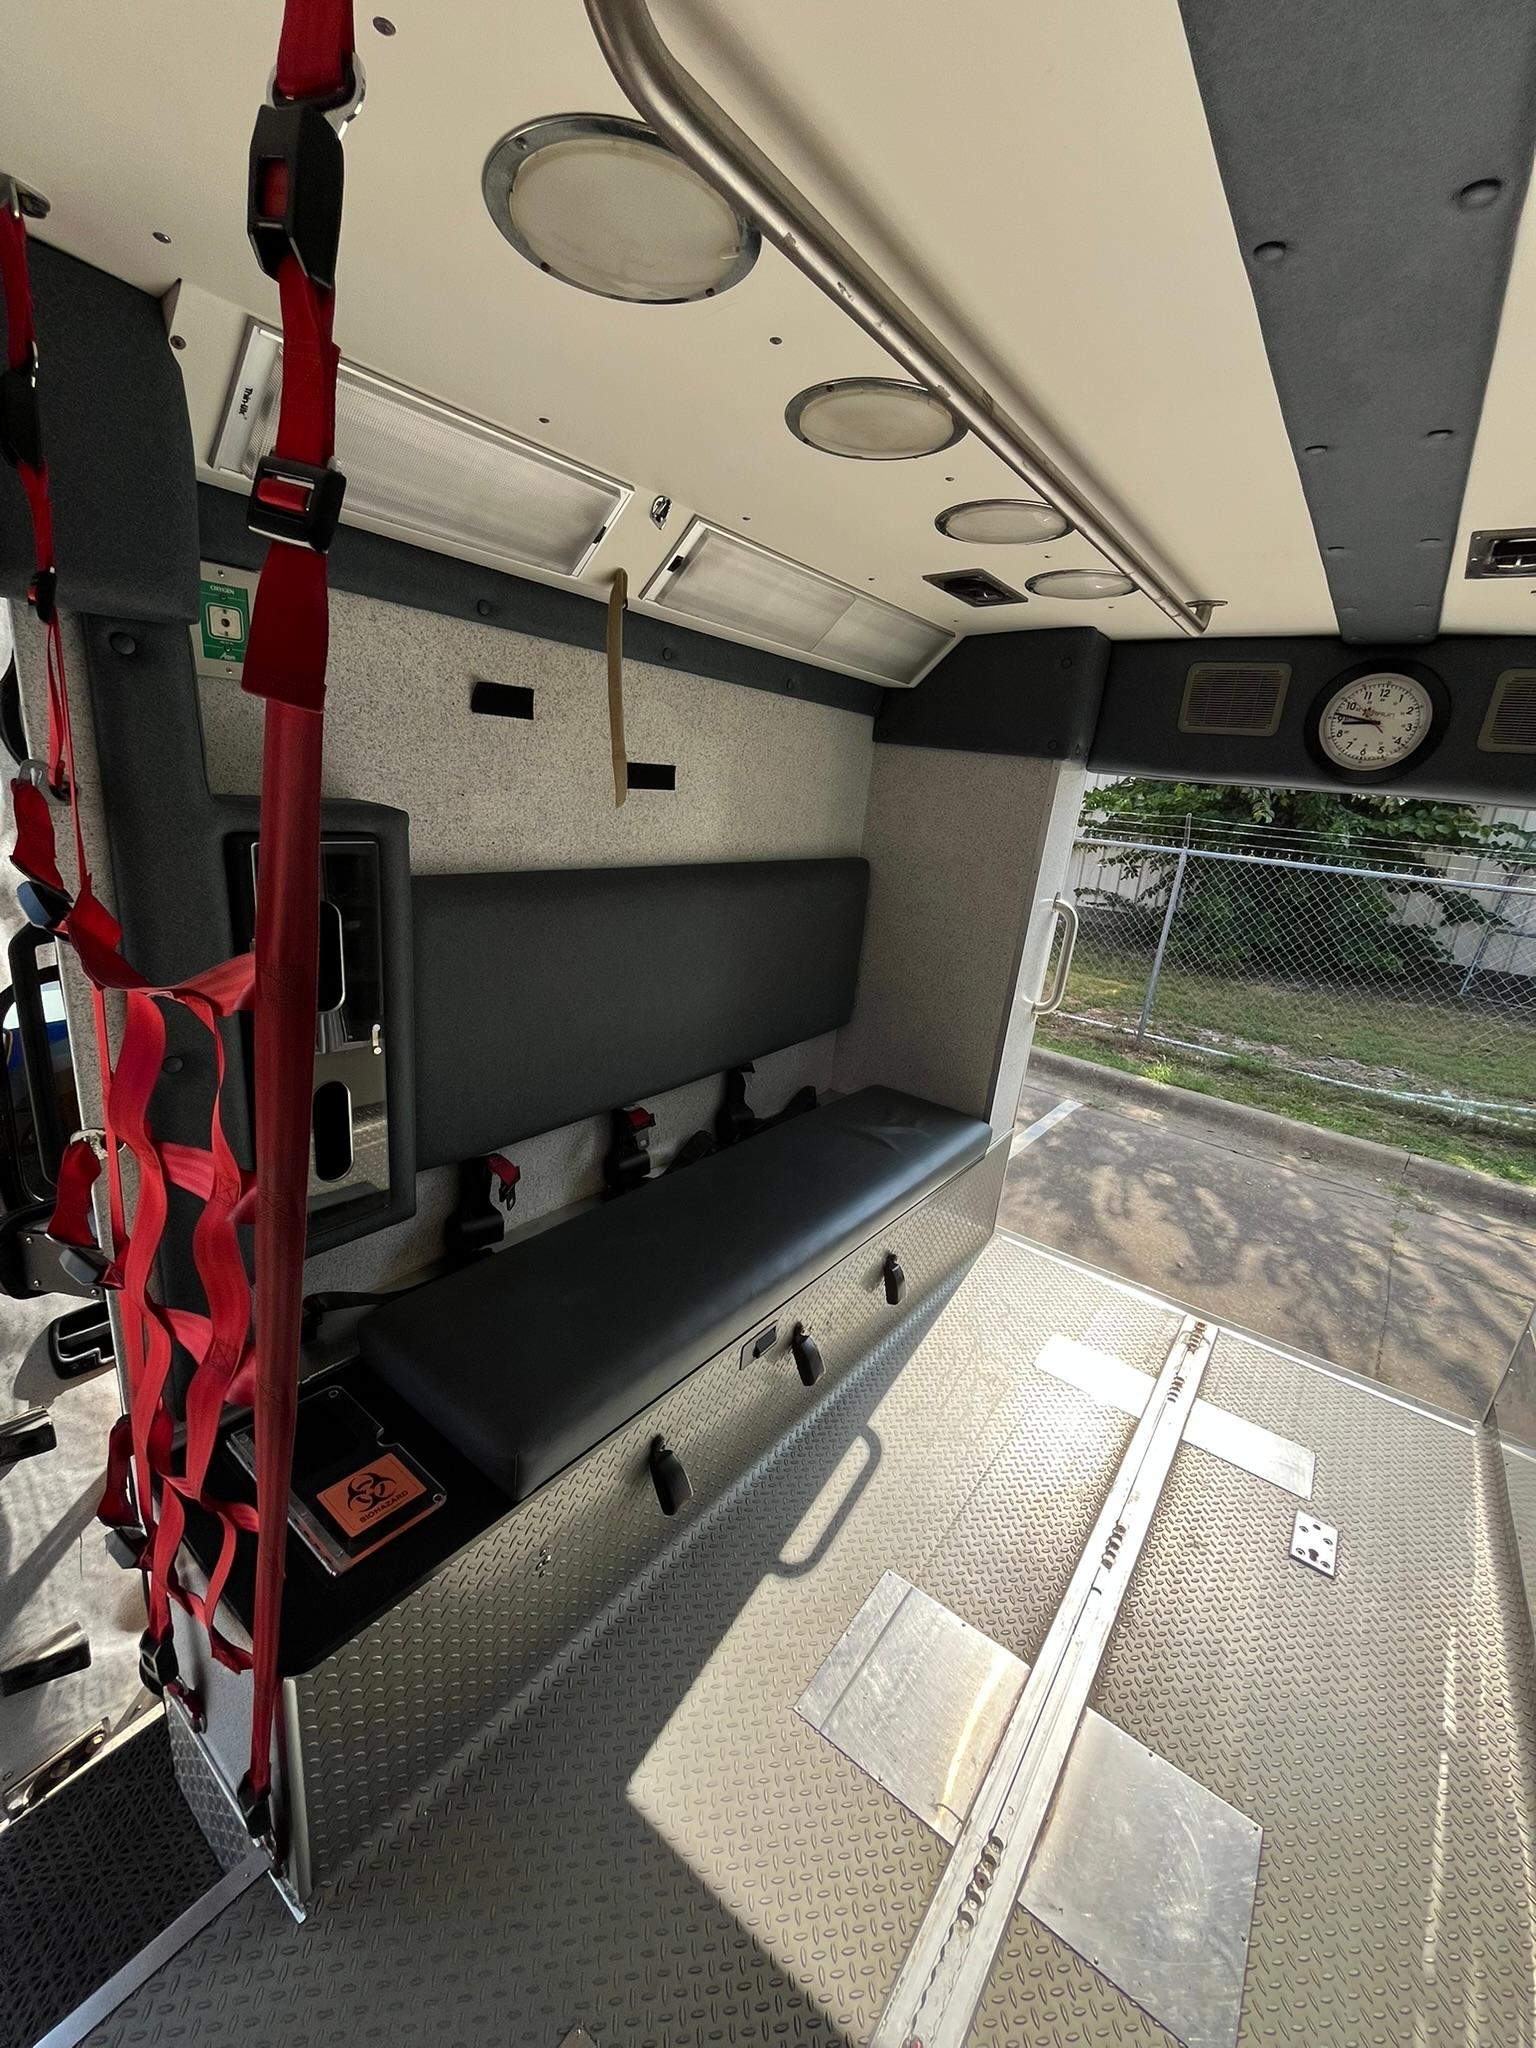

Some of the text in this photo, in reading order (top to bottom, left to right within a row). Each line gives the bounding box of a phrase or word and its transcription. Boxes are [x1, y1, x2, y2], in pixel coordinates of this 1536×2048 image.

[1364, 691, 1373, 700] 11
[1380, 689, 1391, 698] 12
[1399, 694, 1404, 703] 1
[1347, 702, 1357, 711] 10
[1406, 706, 1414, 715] 2
[1337, 715, 1344, 724] 9
[1405, 723, 1413, 732] 3
[1336, 730, 1343, 738] 8
[1394, 736, 1402, 745] 4
[1345, 741, 1353, 750] 7
[1378, 746, 1385, 754] 5
[1360, 748, 1366, 756] 6
[359, 1490, 409, 1523] BIOHAZARD
